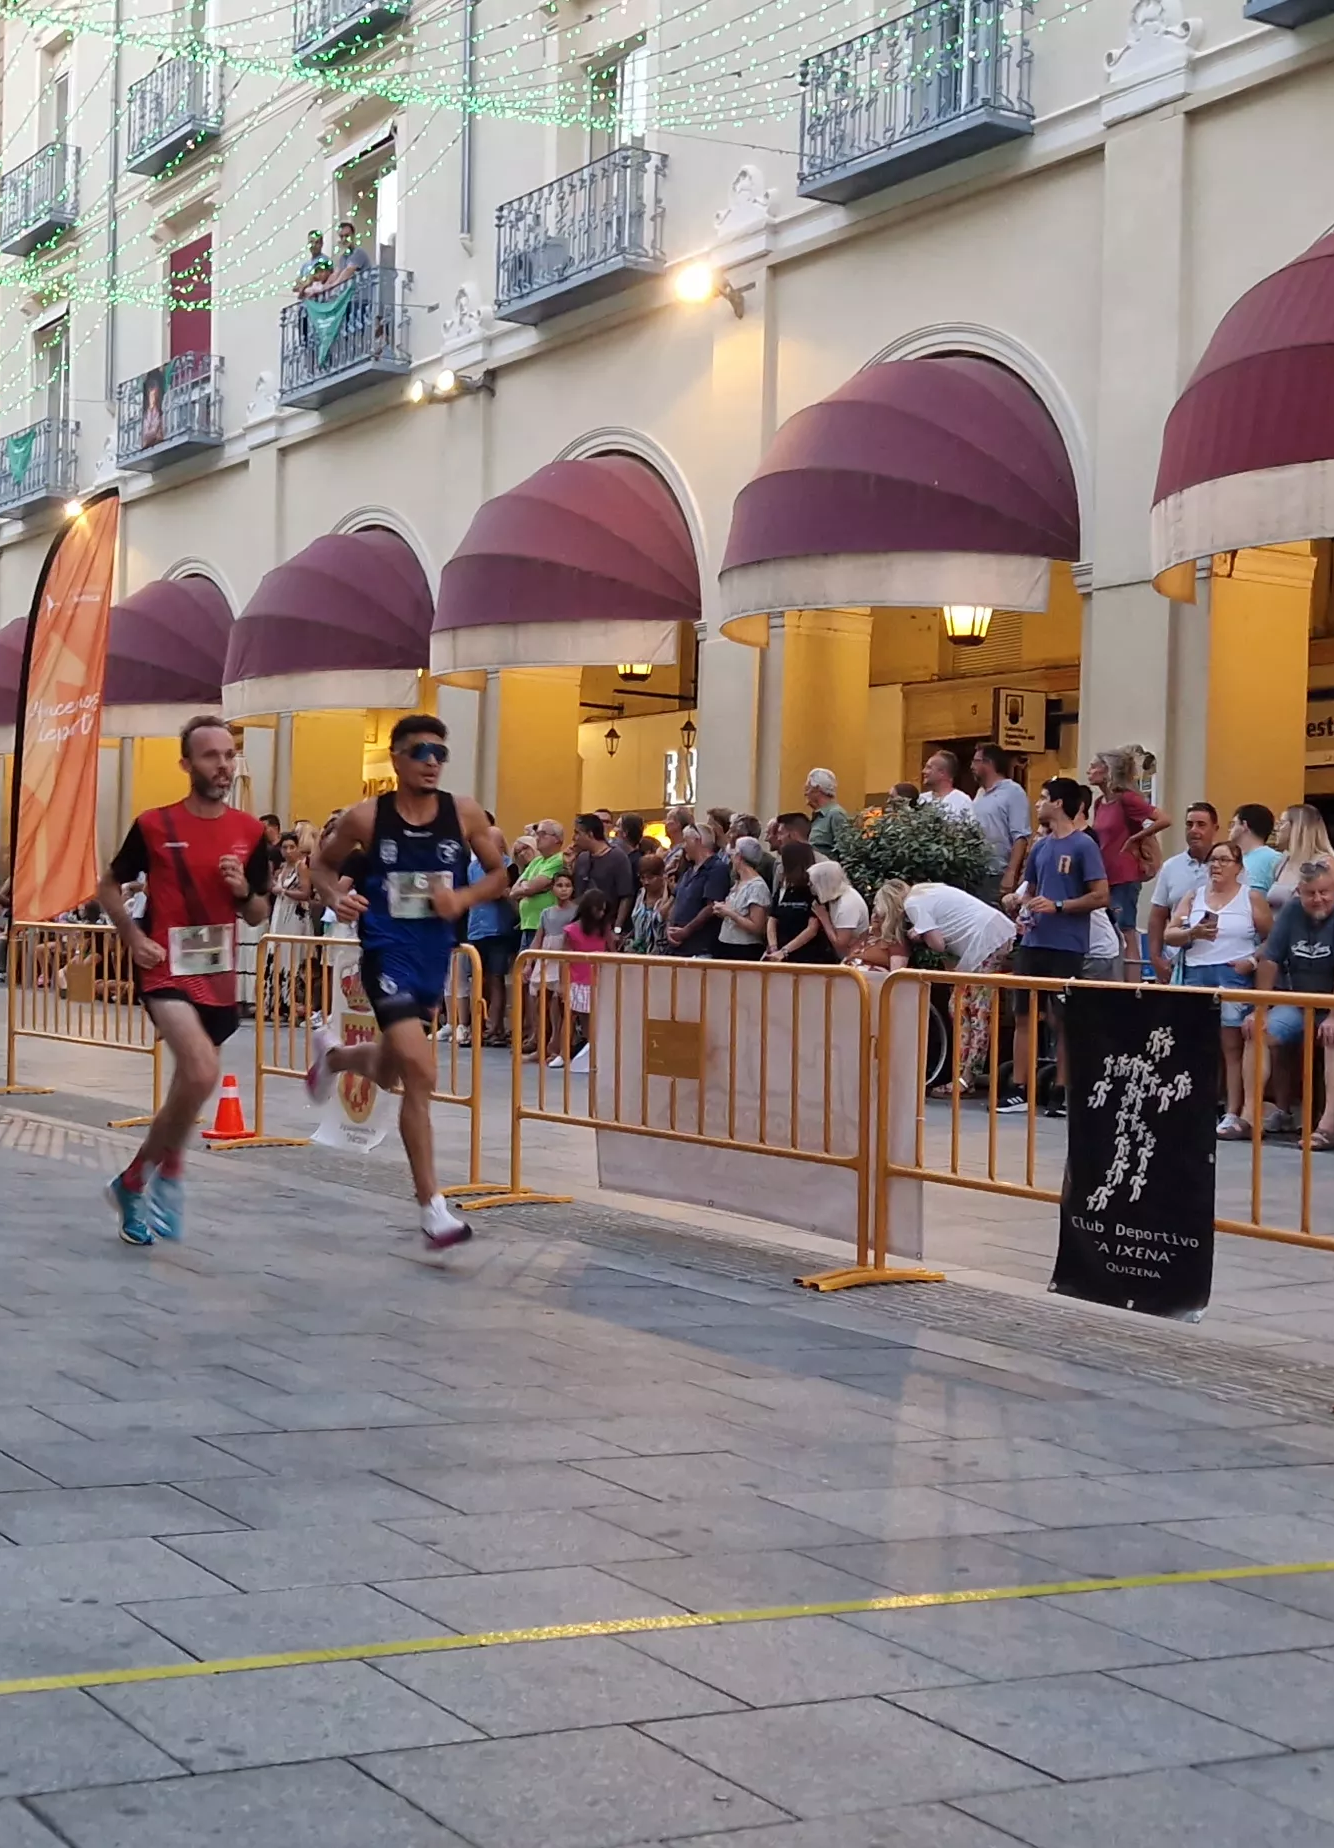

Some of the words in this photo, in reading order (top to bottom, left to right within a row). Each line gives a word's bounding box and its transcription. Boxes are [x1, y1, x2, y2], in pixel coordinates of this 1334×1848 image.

[1071, 1215, 1105, 1233] Club
[1115, 1223, 1200, 1249] Deportivo
[1105, 1262, 1162, 1279] QUIZENA
